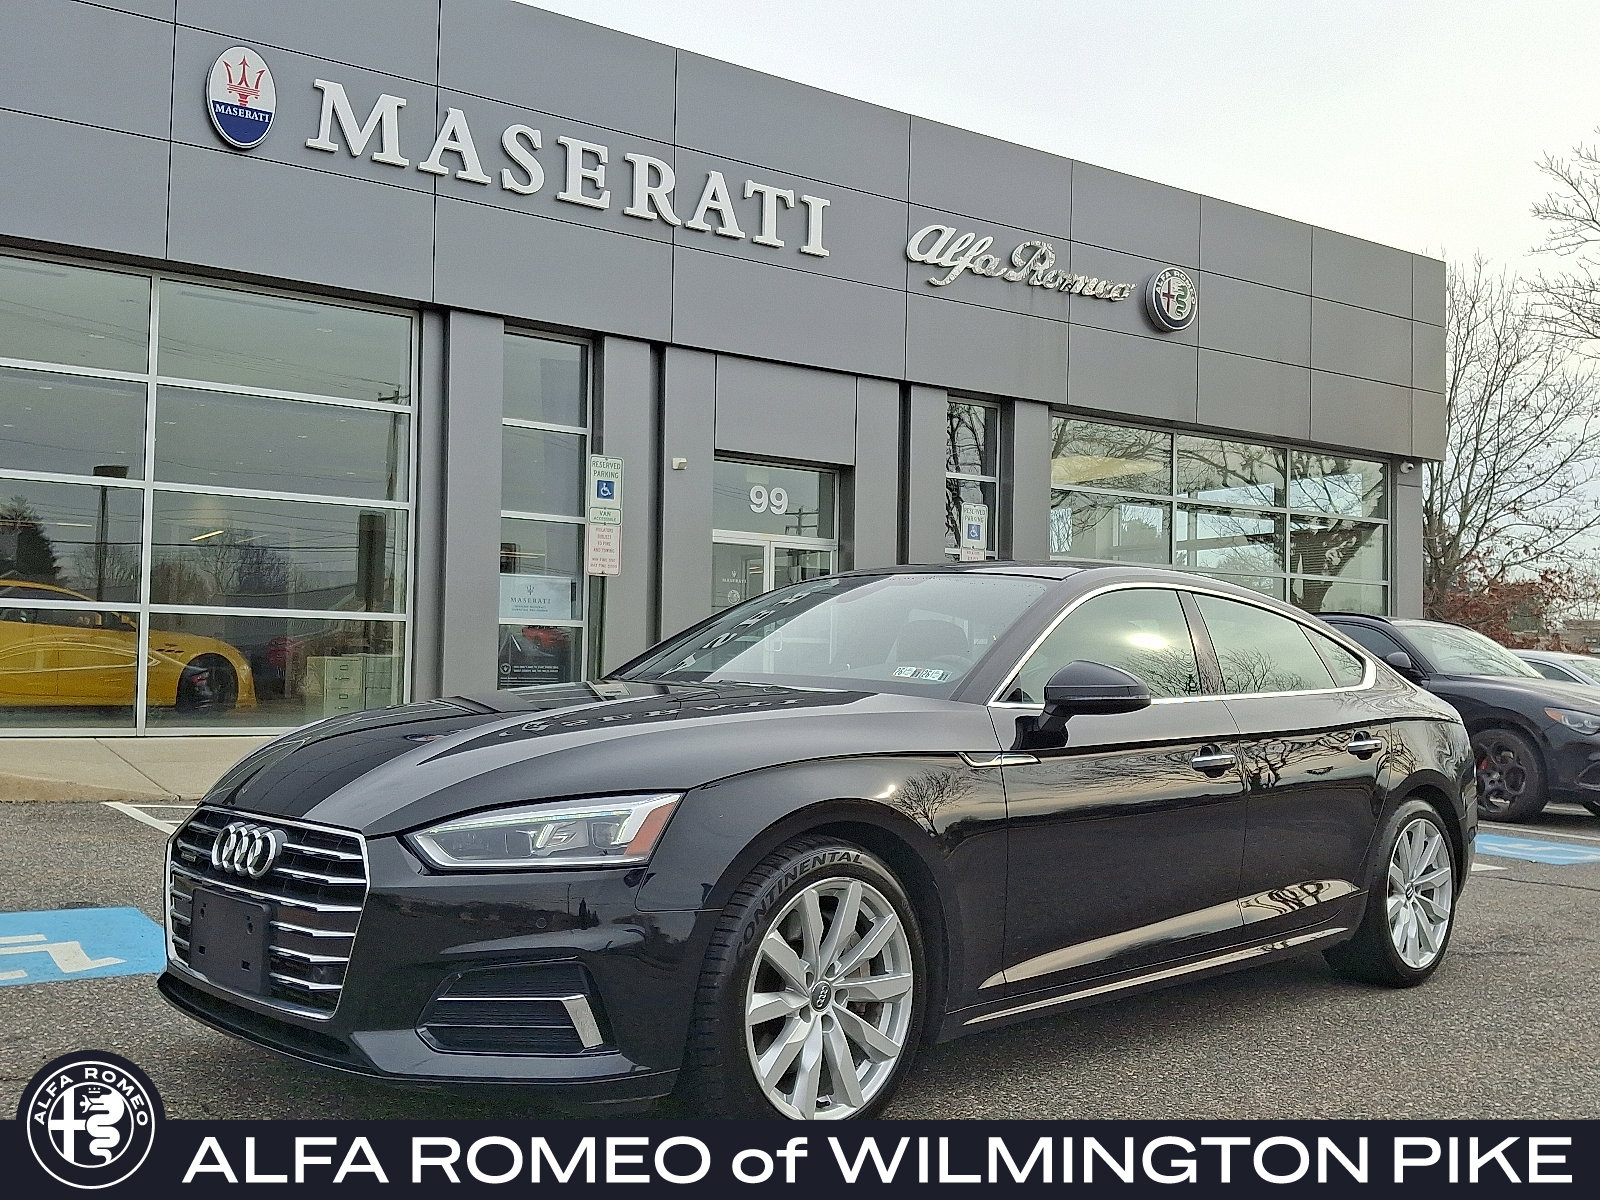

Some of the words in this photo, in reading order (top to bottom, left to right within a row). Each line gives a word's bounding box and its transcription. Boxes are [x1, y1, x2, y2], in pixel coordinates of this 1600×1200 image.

[214, 103, 270, 123] MASERATI
[305, 79, 831, 258] MASERATI
[906, 224, 1008, 287] Alfa
[1002, 240, 1138, 302] Romeo
[1155, 271, 1172, 295] ALFA
[591, 460, 621, 470] RESERVED
[593, 470, 619, 479] PARKING
[749, 485, 789, 515] 99
[510, 597, 551, 605] MASERATI
